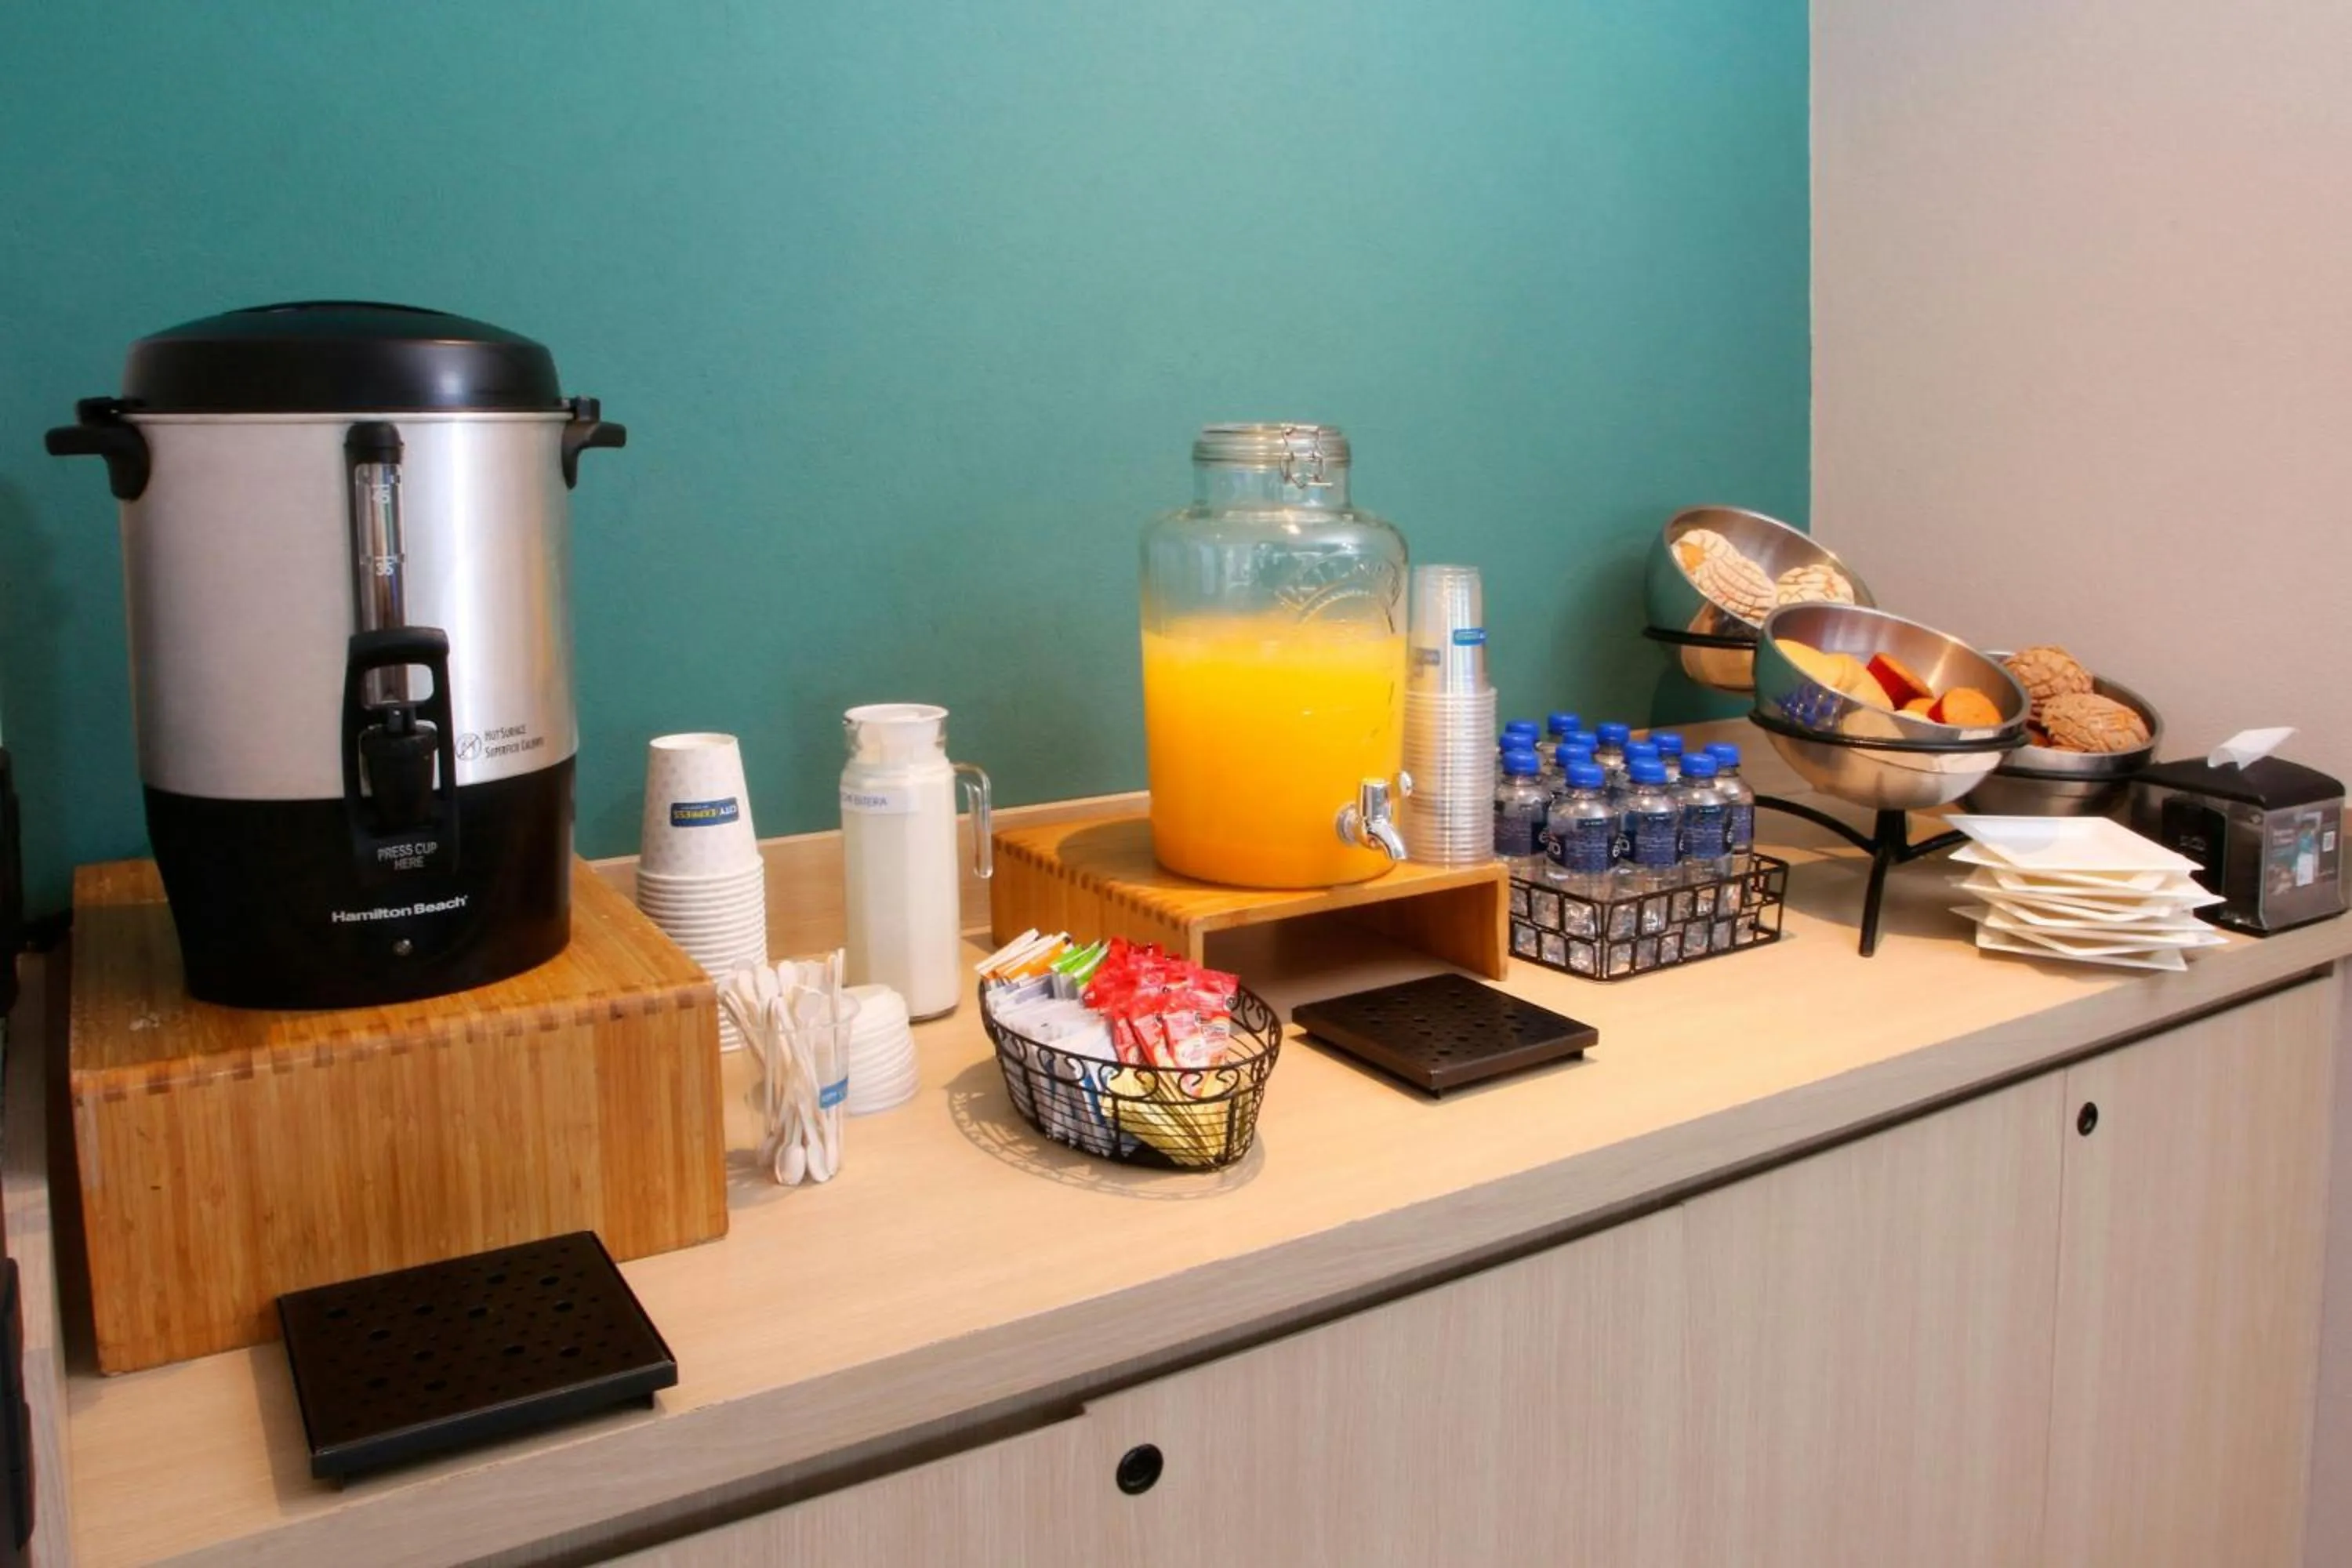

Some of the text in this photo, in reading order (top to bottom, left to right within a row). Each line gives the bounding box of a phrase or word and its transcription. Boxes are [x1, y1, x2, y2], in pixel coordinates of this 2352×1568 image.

[377, 841, 437, 862] PRESS CUP
[394, 855, 425, 870] HERE
[331, 896, 466, 923] Hamilton Beach
